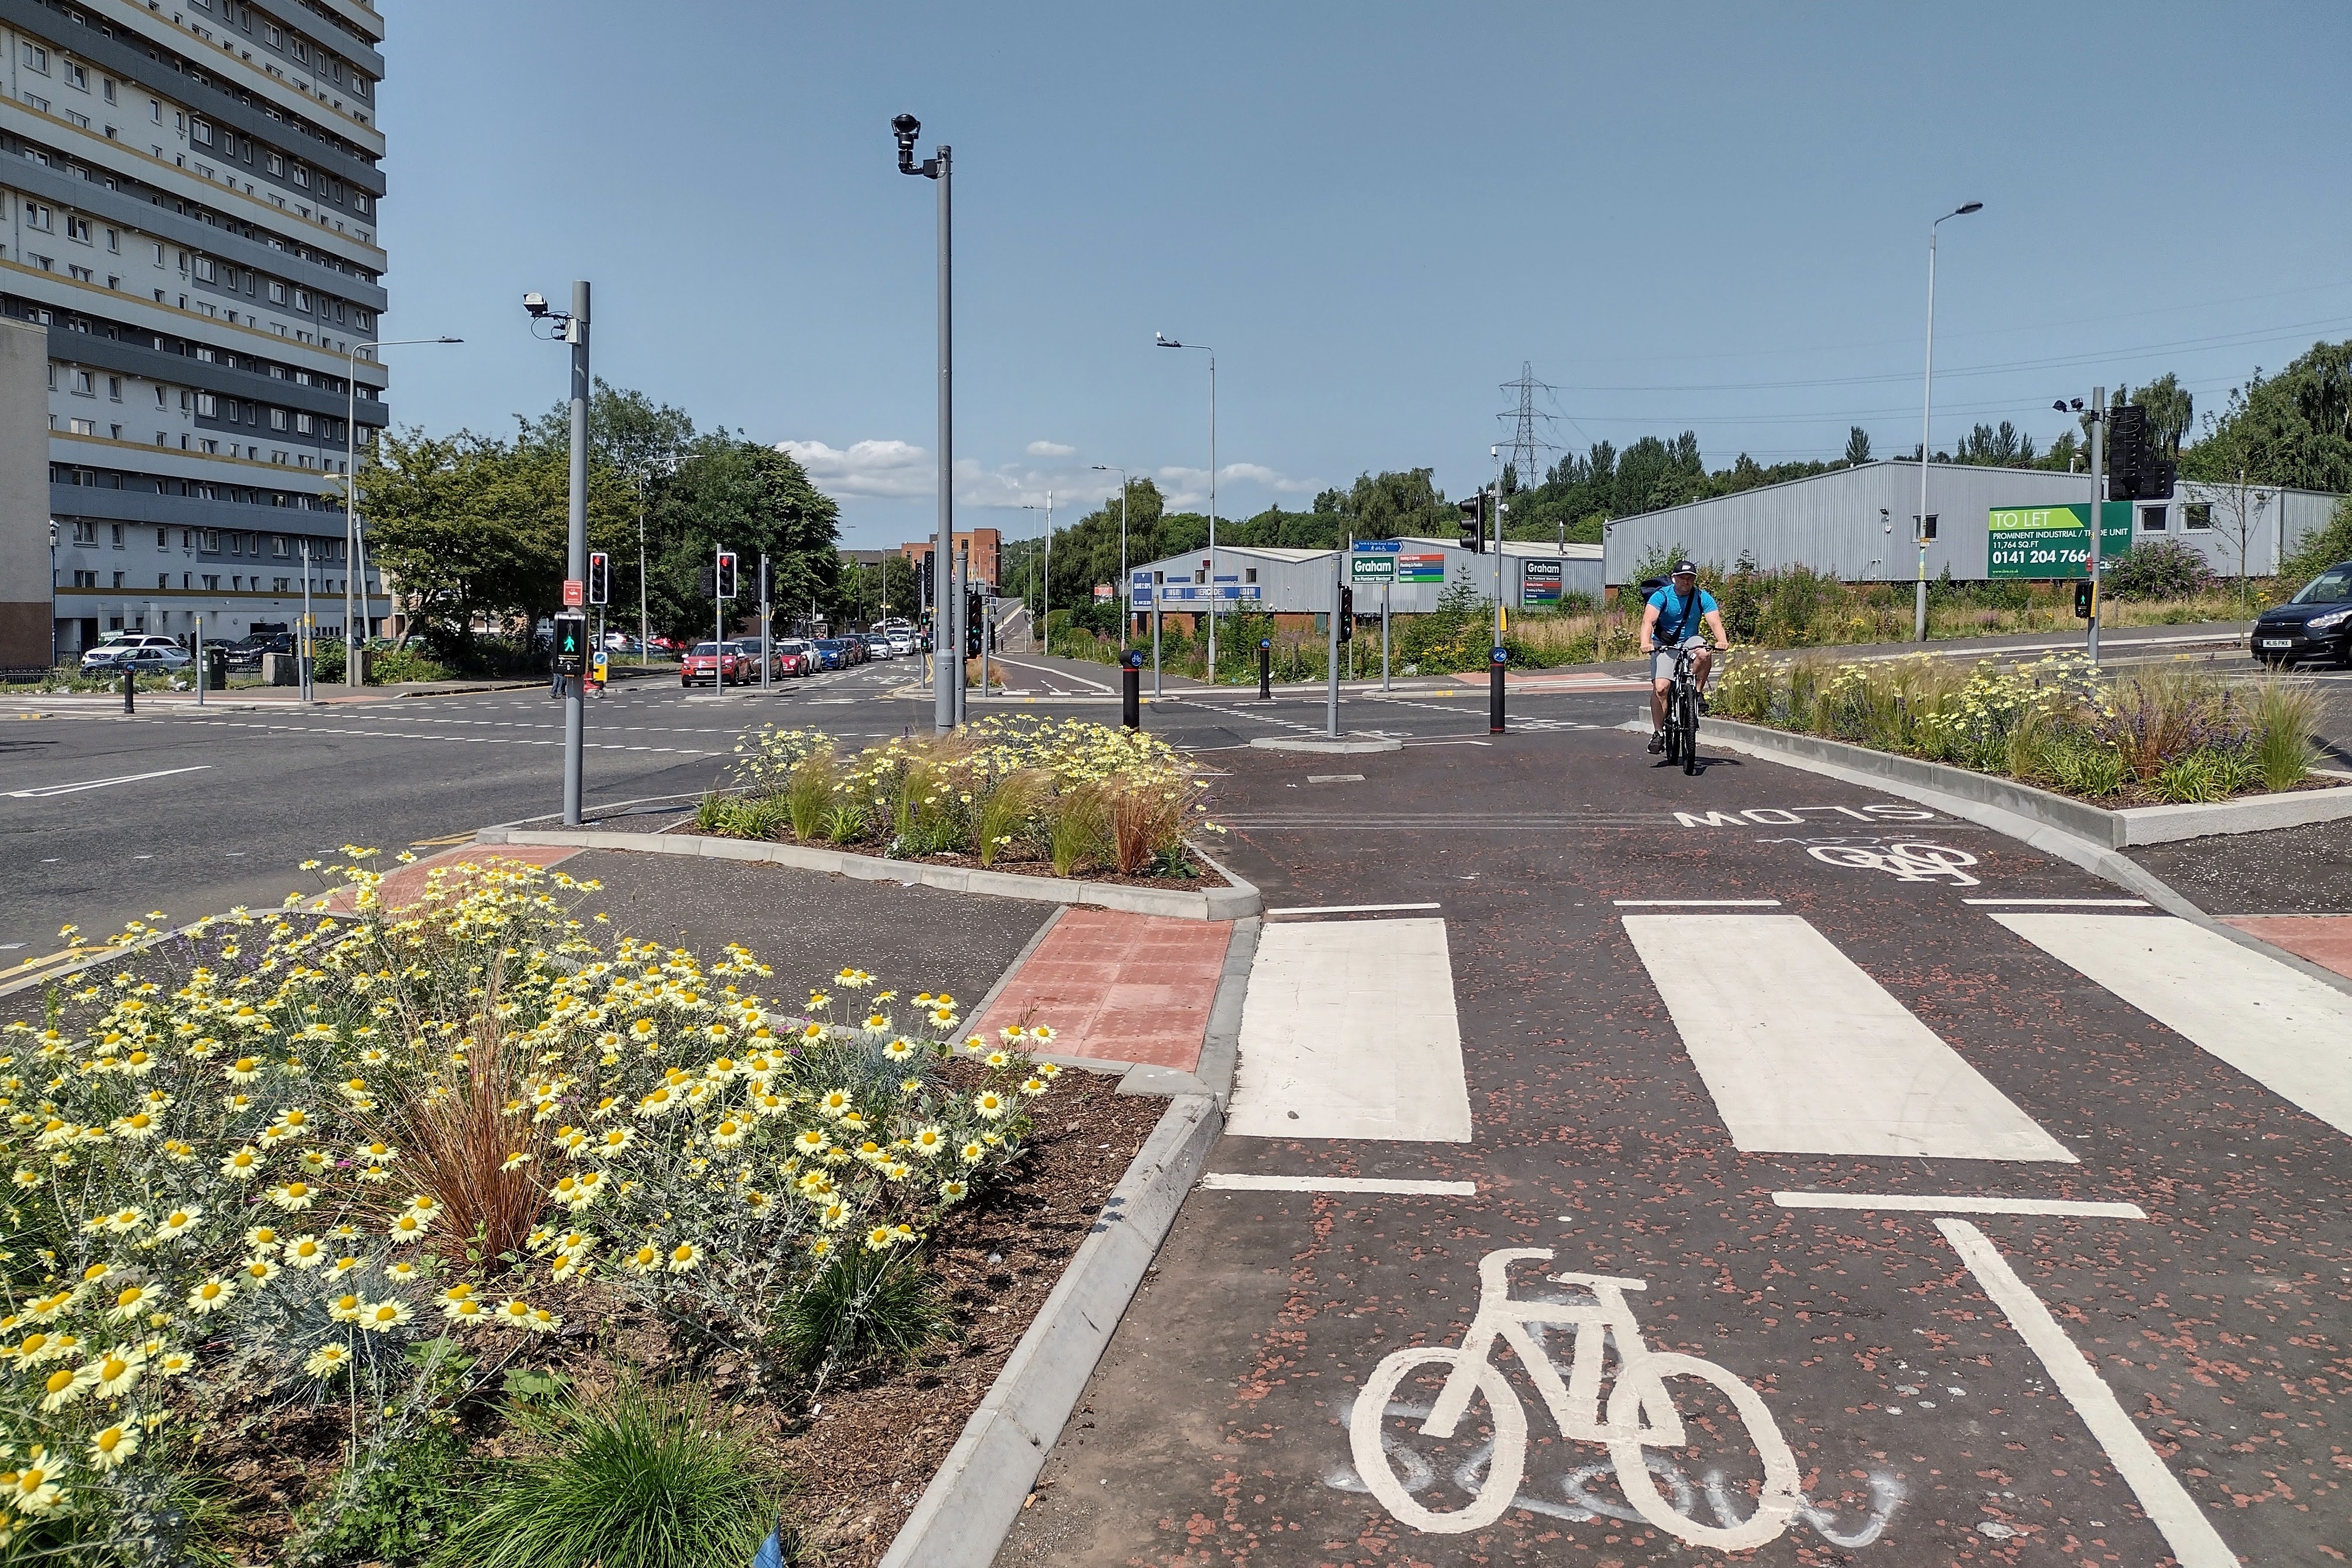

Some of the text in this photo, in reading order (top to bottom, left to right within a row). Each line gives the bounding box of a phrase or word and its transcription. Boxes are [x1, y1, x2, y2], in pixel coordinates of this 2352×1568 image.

[1994, 511, 2050, 528] TO LET
[1993, 531, 2034, 540] PROMINENT
[2036, 530, 2077, 539] INDUSTRIAL
[2109, 528, 2129, 536] UNIT
[1992, 540, 2039, 550] 11,764 SQ.FT
[1992, 550, 2024, 564] 0141
[2029, 550, 2057, 564] 204
[1354, 560, 1391, 573] Graham
[1528, 563, 1559, 573] Graham
[1672, 804, 1936, 828] SLOW
